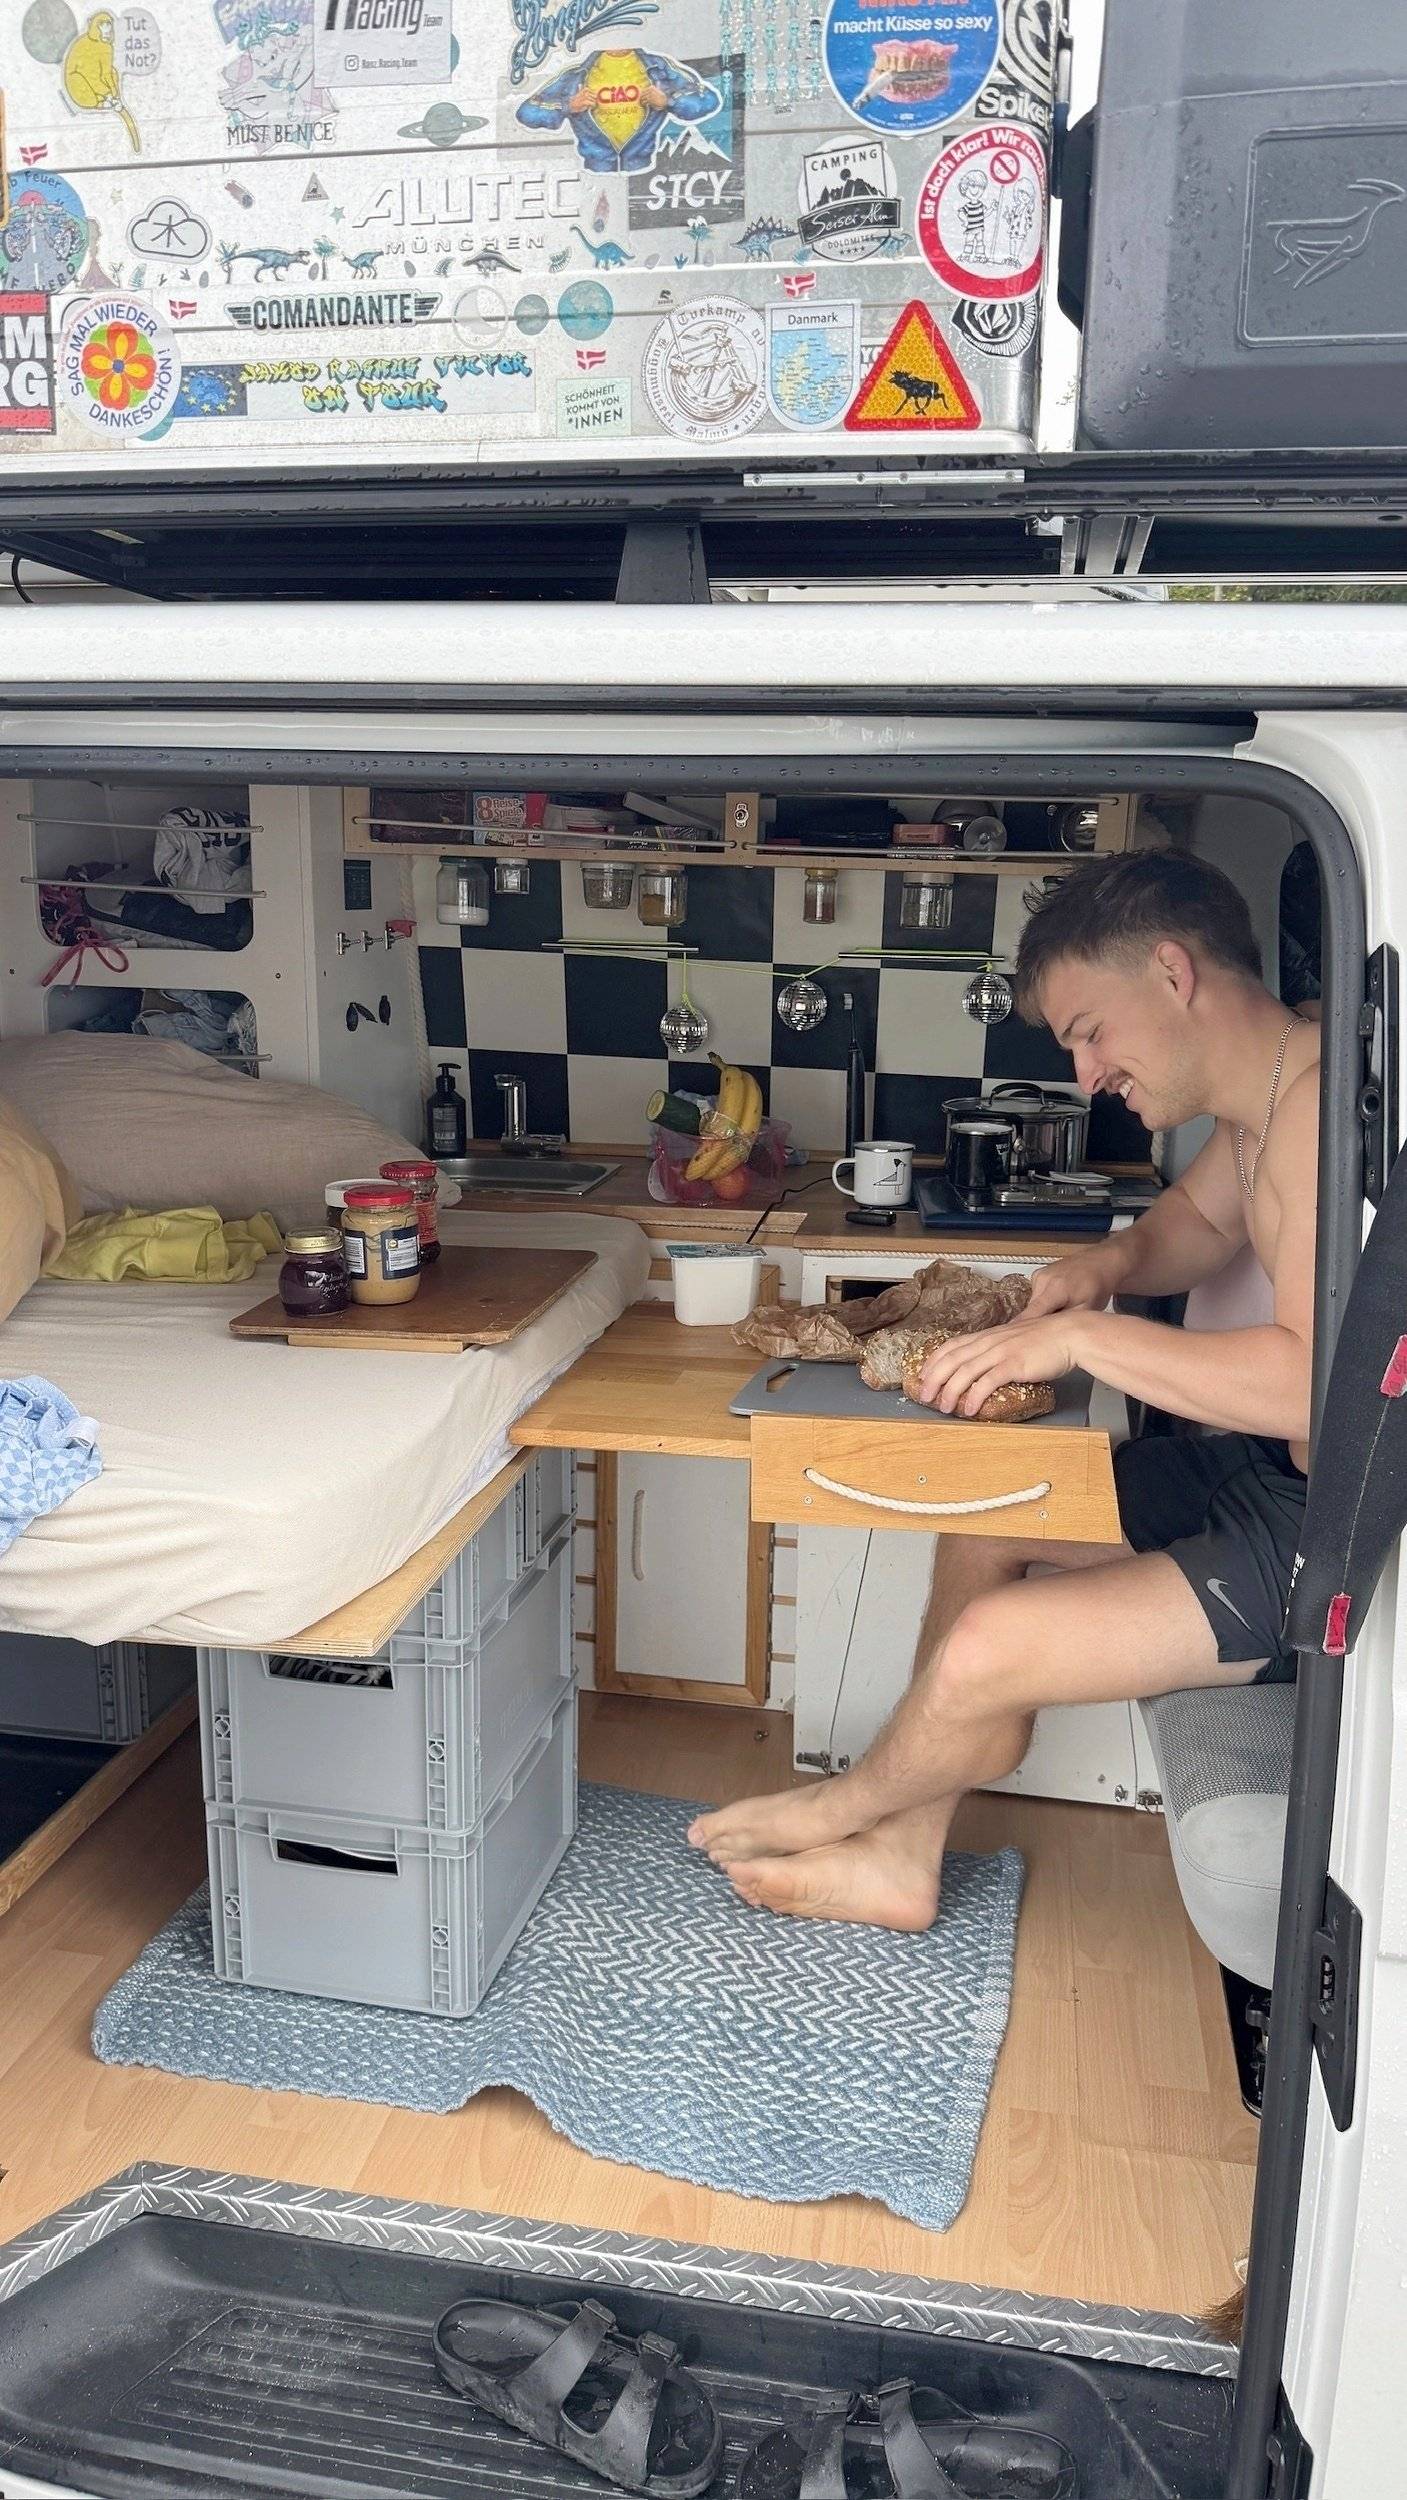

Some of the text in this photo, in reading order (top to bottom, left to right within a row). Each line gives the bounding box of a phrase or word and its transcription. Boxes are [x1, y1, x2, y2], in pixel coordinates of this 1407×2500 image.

[123, 16, 148, 31] Tut
[833, 15, 993, 34] macht Küsse so sexy
[124, 36, 151, 49] das
[124, 54, 157, 67] Not?
[978, 87, 1050, 130] Spike
[226, 121, 334, 146] MUST BE NICE
[991, 128, 1021, 149] Wir
[950, 132, 989, 163] klar!
[811, 149, 878, 172] CAMPING
[24, 170, 62, 189] Feuer
[926, 161, 956, 198] doch
[352, 171, 581, 229] ALUTEC
[920, 199, 936, 220] Ist
[805, 201, 894, 241] Seiser Alm
[384, 235, 545, 256] MÜNCHEN
[253, 293, 415, 330] COMANDANTE
[787, 312, 839, 325] Danmark
[0, 315, 48, 359] M
[65, 303, 158, 397] SAG MAL WIEDER
[302, 379, 448, 413] ON TOUR
[564, 383, 616, 404] SCHÖNHEIT
[566, 395, 620, 415] KOMMT VON
[476, 796, 494, 821] 8
